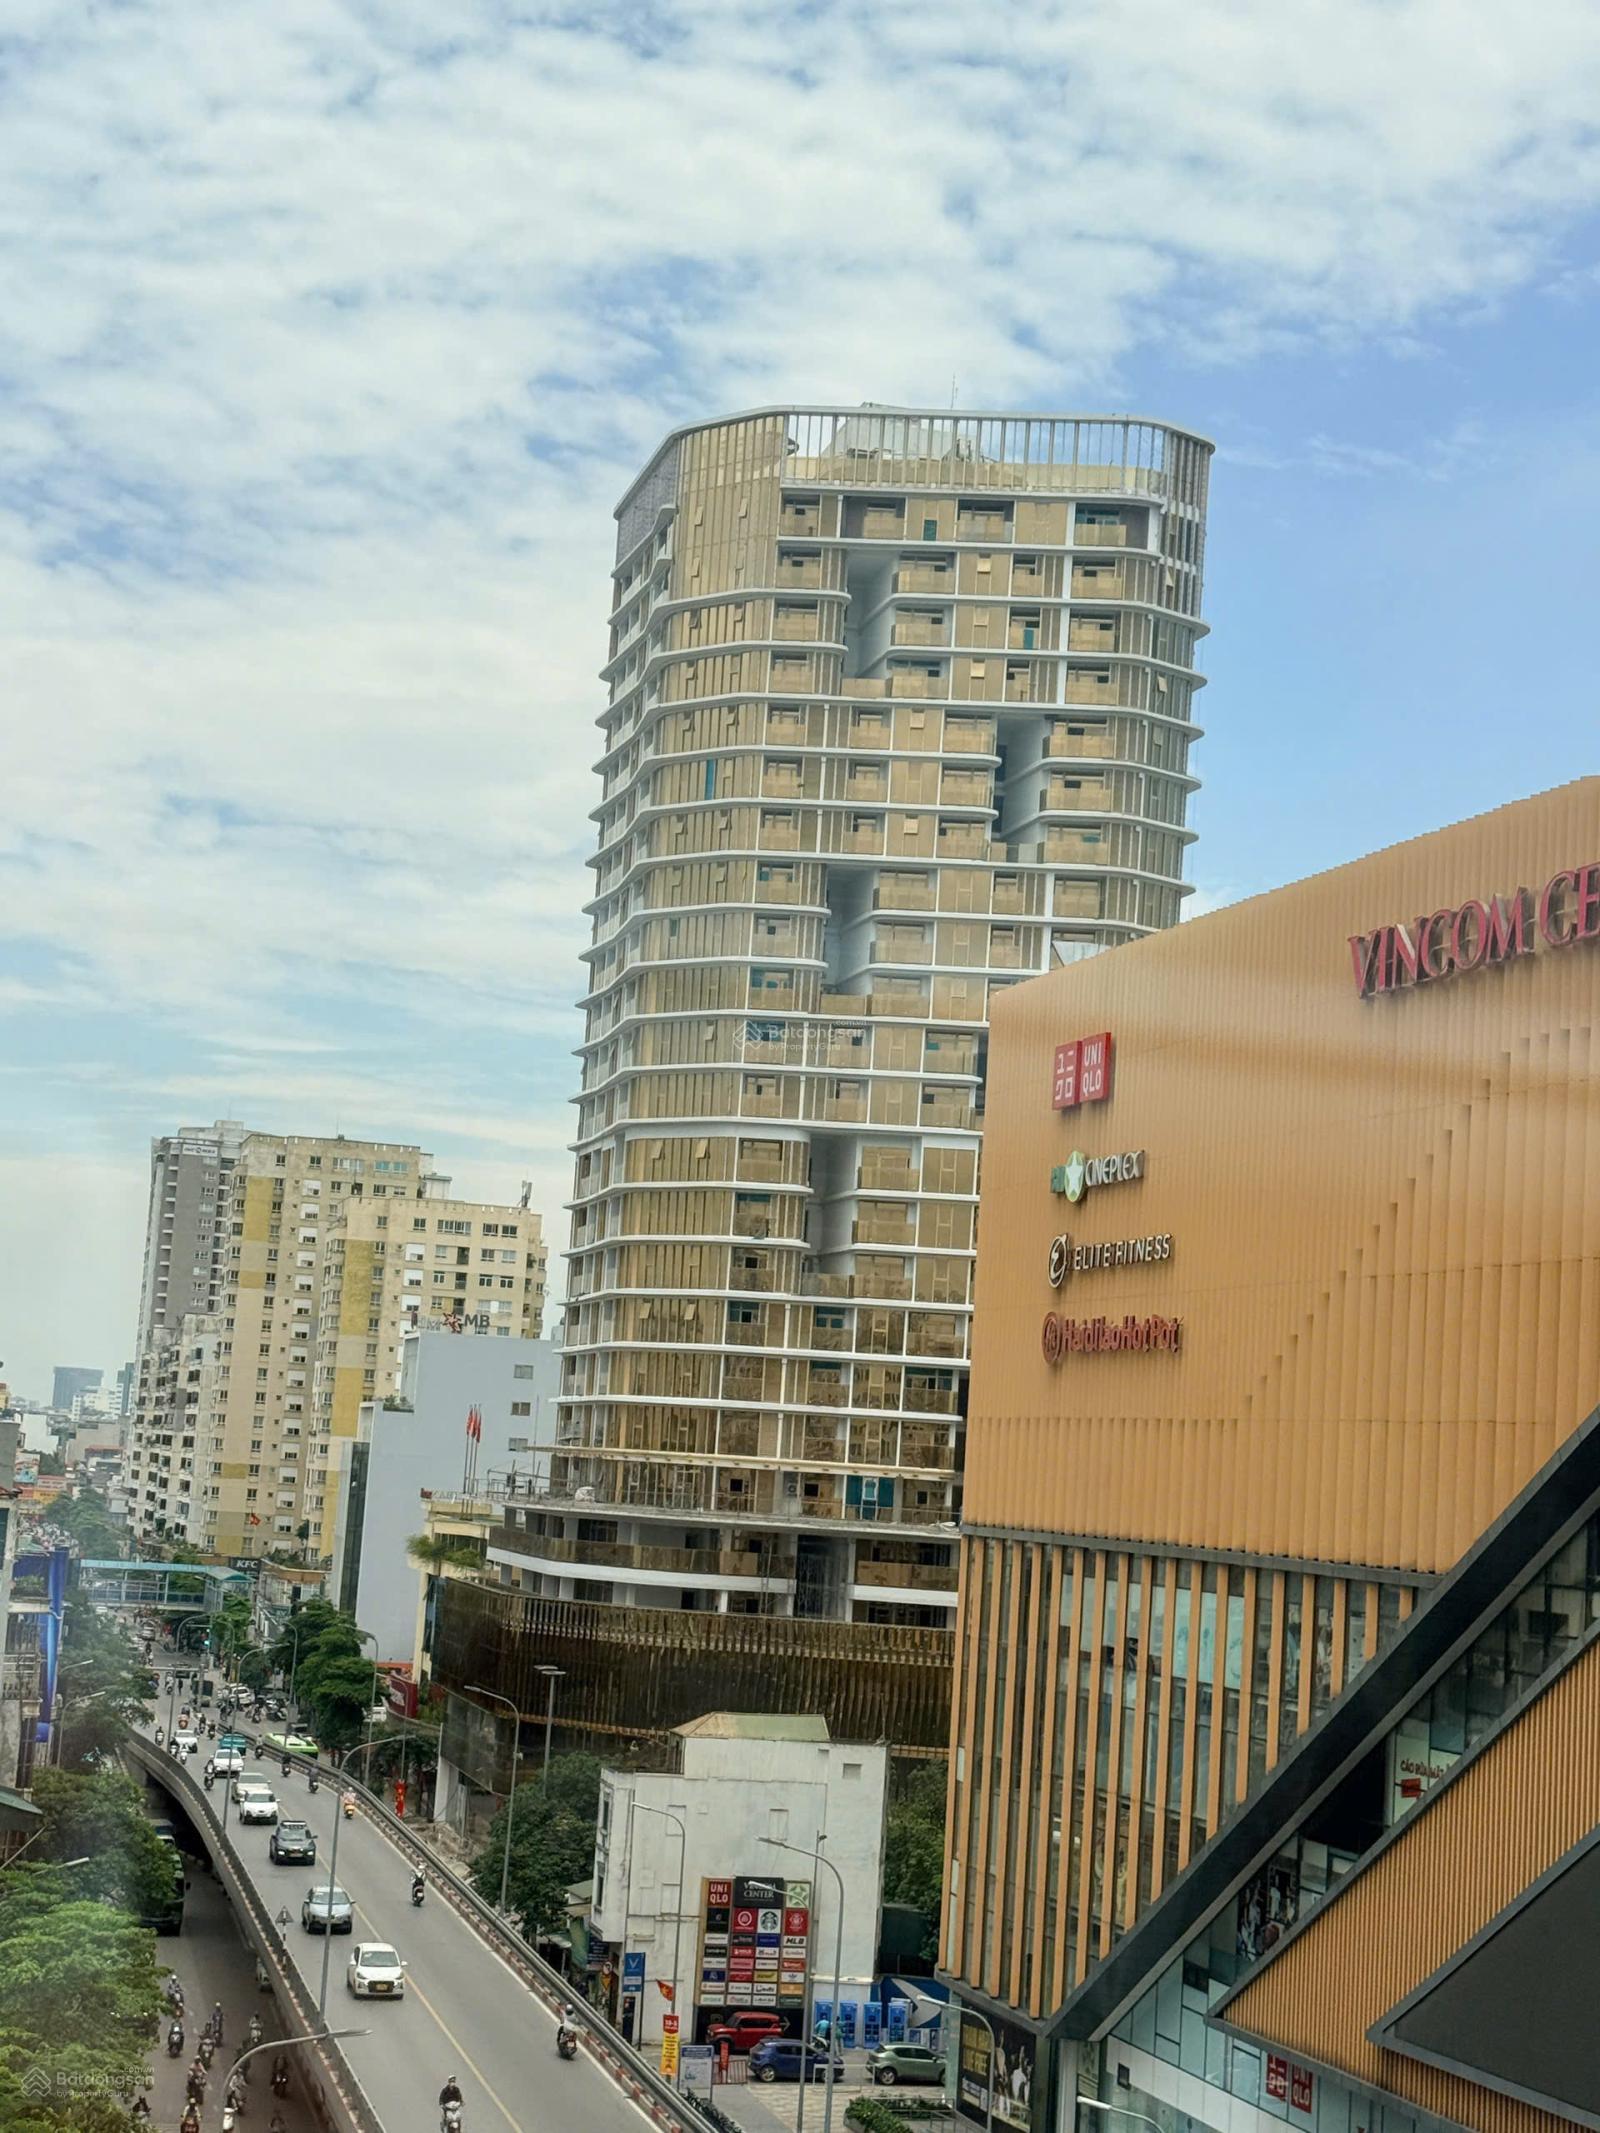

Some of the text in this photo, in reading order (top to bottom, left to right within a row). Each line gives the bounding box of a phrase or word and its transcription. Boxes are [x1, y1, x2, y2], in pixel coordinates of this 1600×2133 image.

[1347, 886, 1534, 999] VINCOM
[1057, 1050, 1074, 1075] ユニ
[1084, 1041, 1102, 1067] UNI
[1055, 1077, 1073, 1101] クロ
[1082, 1068, 1101, 1097] QLO
[1085, 1151, 1143, 1187] CINEPLEX
[1074, 1233, 1172, 1270] ELITE FITNESS
[464, 1313, 490, 1328] MB
[236, 1560, 258, 1569] KFC
[709, 1893, 728, 1904] QLO
[710, 1883, 727, 1893] UNI
[743, 1890, 775, 1898] CENTER
[785, 1937, 804, 1945] MLB
